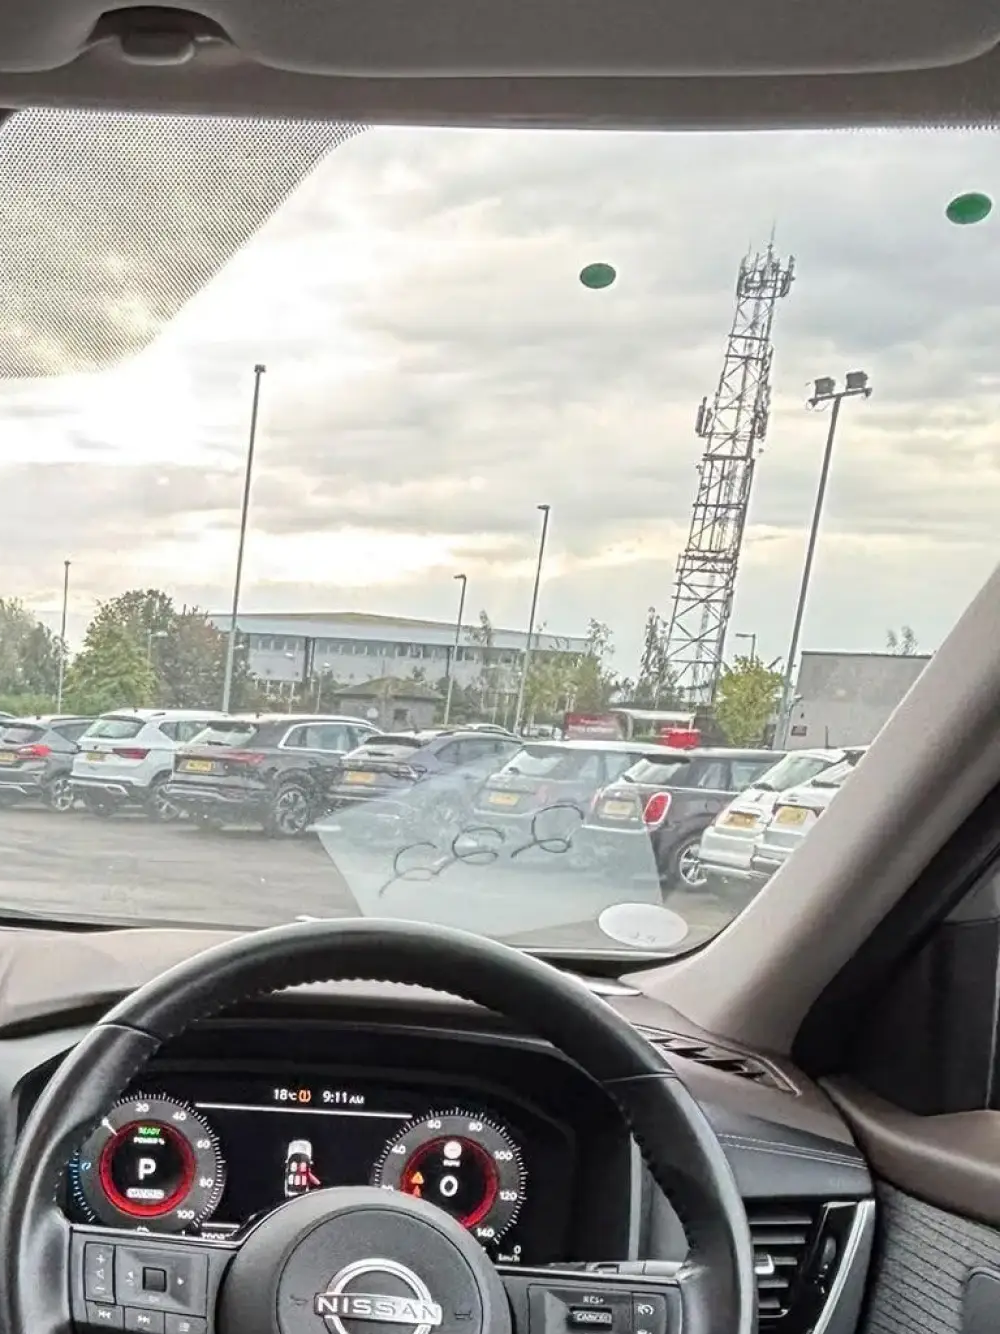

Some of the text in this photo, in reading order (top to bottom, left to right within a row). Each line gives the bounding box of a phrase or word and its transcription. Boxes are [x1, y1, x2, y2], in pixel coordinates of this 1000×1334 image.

[136, 1102, 150, 1113] 20
[172, 1111, 187, 1121] 40
[494, 1151, 513, 1161] 100
[138, 1157, 157, 1180] P
[439, 1175, 458, 1197] 0
[499, 1190, 518, 1201] 120
[176, 1210, 195, 1220] 100
[477, 1227, 495, 1238] 140
[317, 1296, 439, 1323] NISSAN
